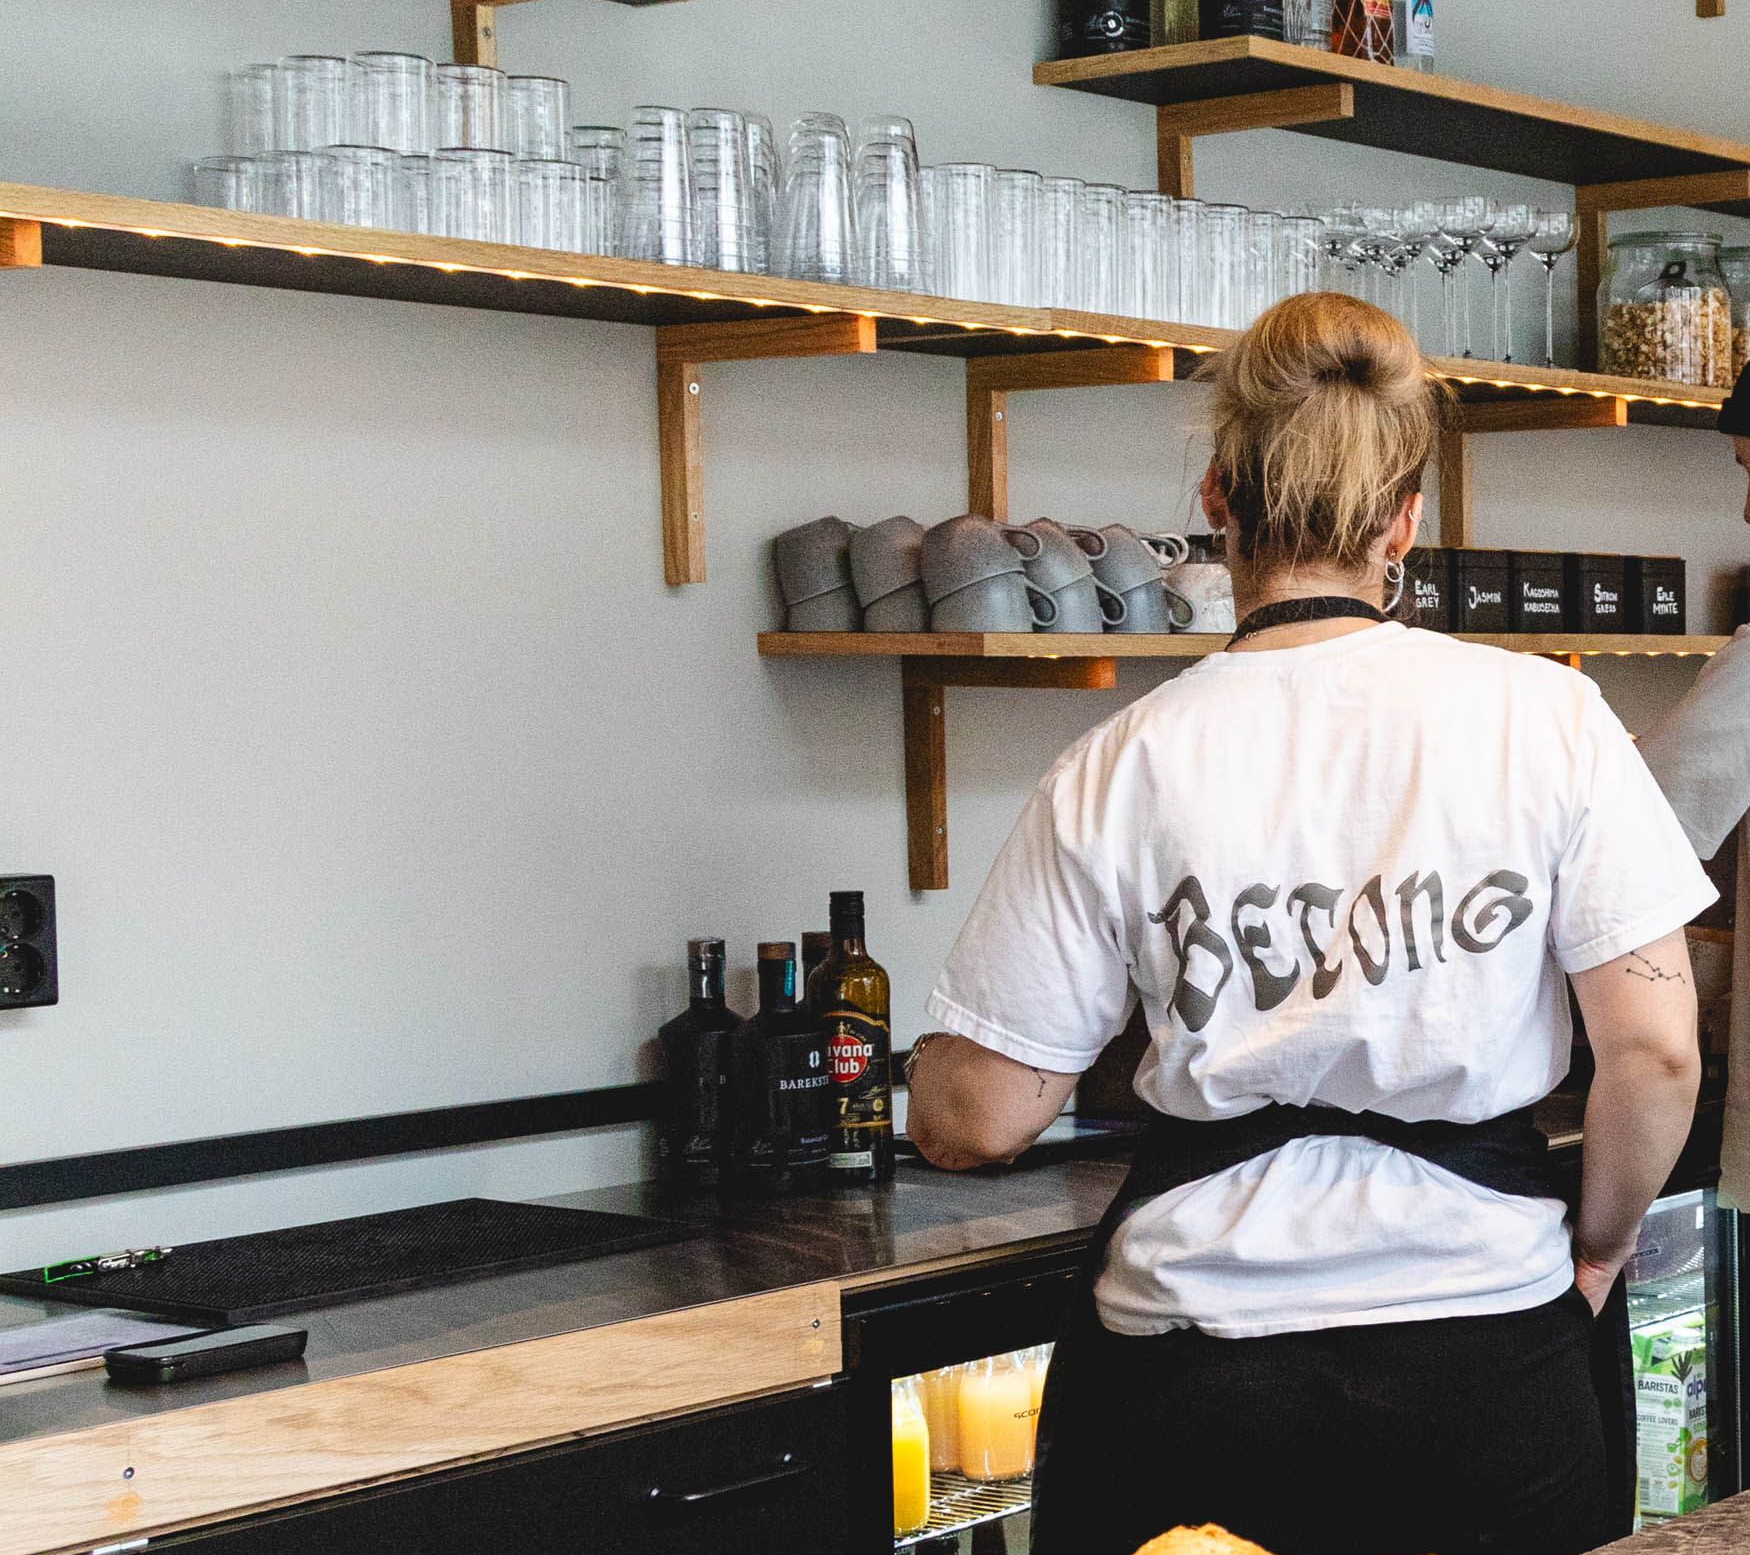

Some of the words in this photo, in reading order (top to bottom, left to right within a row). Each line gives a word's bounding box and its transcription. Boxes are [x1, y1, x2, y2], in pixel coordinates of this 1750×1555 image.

[1415, 580, 1439, 596] EARL
[1416, 597, 1439, 608] GREY
[1469, 586, 1501, 609] JASMIN
[828, 1058, 861, 1074] lub
[1638, 1379, 1679, 1395] BARISTAS
